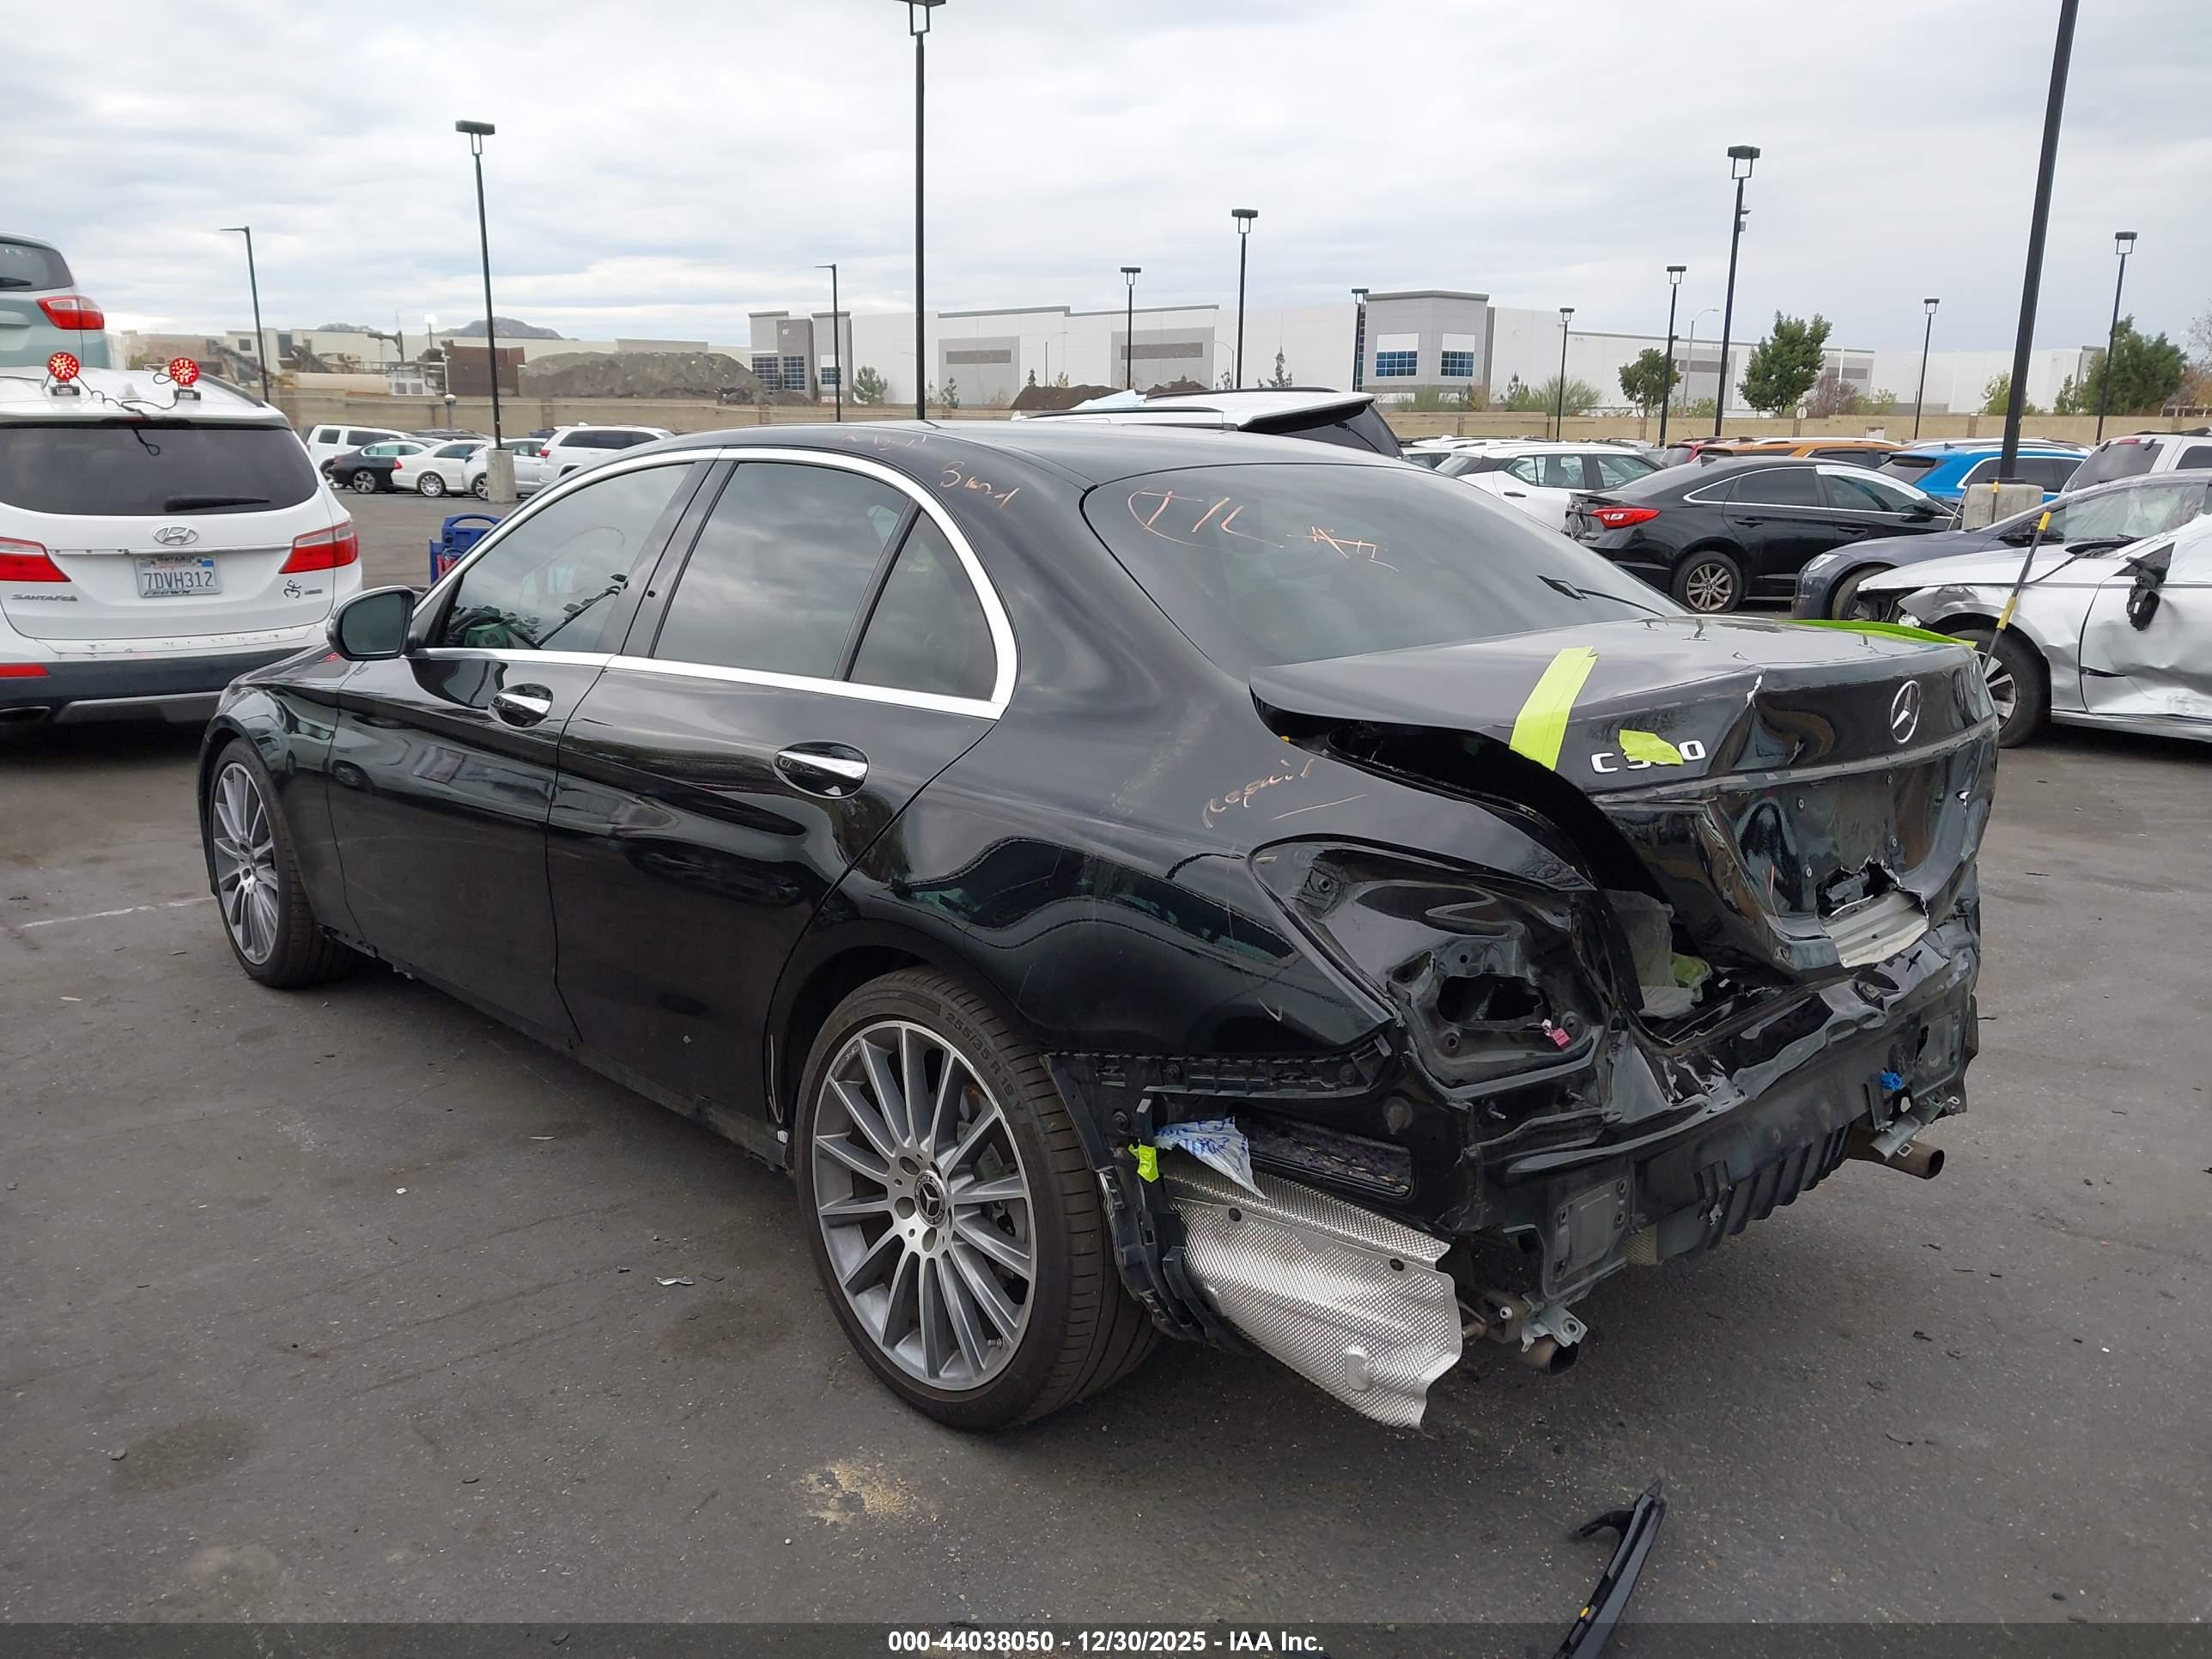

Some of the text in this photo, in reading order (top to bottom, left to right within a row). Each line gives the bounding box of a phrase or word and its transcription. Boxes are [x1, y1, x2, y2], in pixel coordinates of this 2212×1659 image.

[143, 570, 214, 589] 7DVH312
[1590, 739, 1706, 774] C0
[945, 1012, 991, 1060] 255/35
